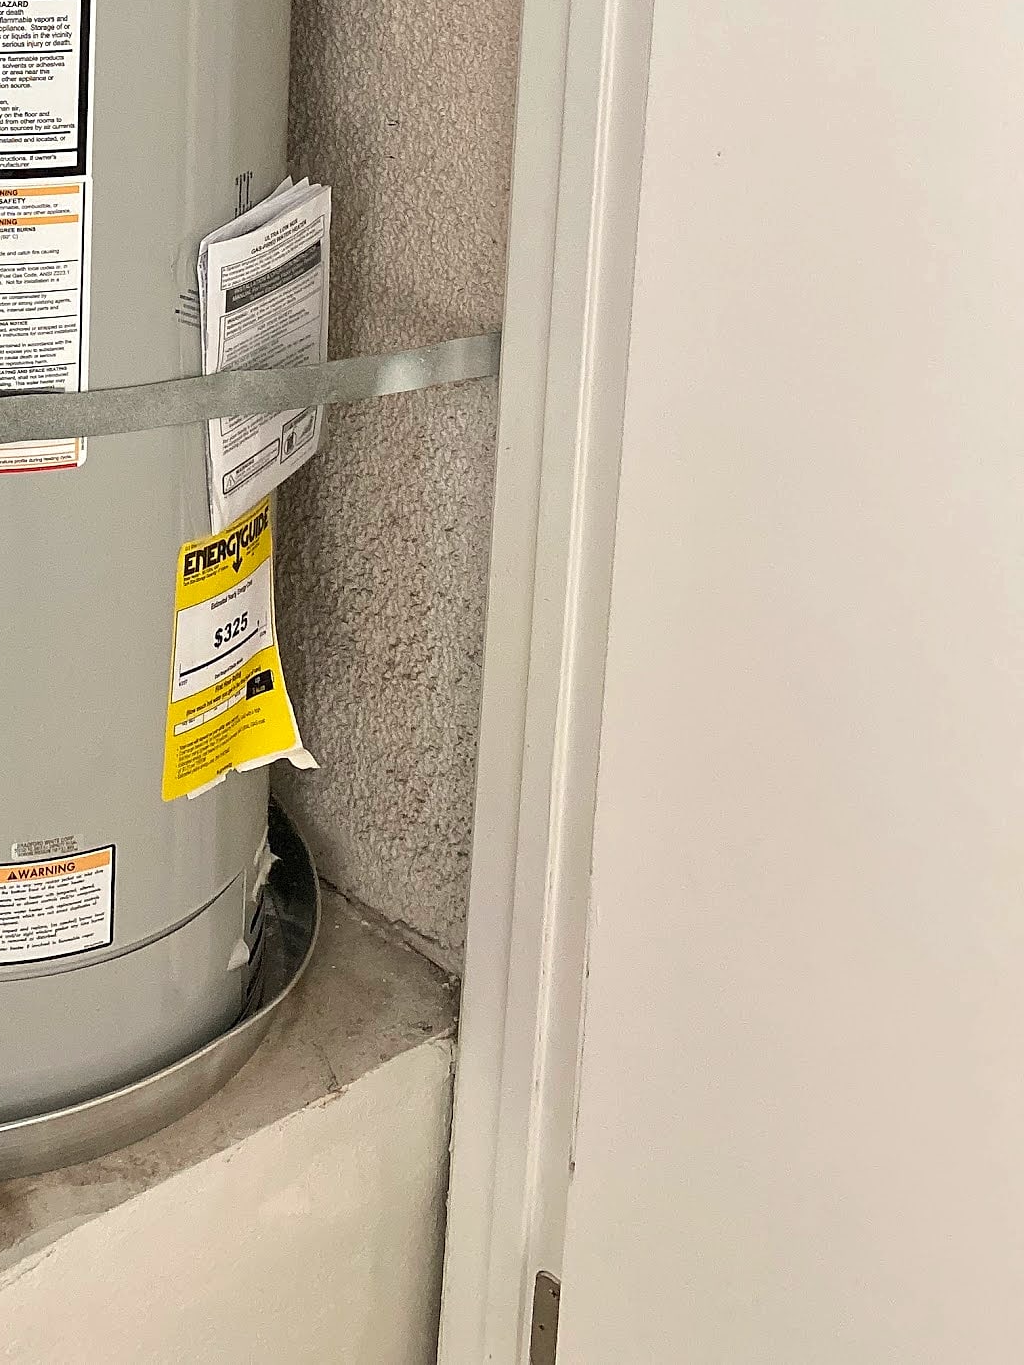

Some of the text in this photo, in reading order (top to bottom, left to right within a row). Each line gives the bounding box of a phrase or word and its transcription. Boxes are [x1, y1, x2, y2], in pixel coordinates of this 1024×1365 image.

[30, 23, 54, 32] Storage
[11, 32, 31, 40] liquids
[51, 31, 72, 40] vicinity
[26, 40, 43, 48] injury
[213, 611, 248, 648] $325
[18, 862, 76, 880] WARNING
